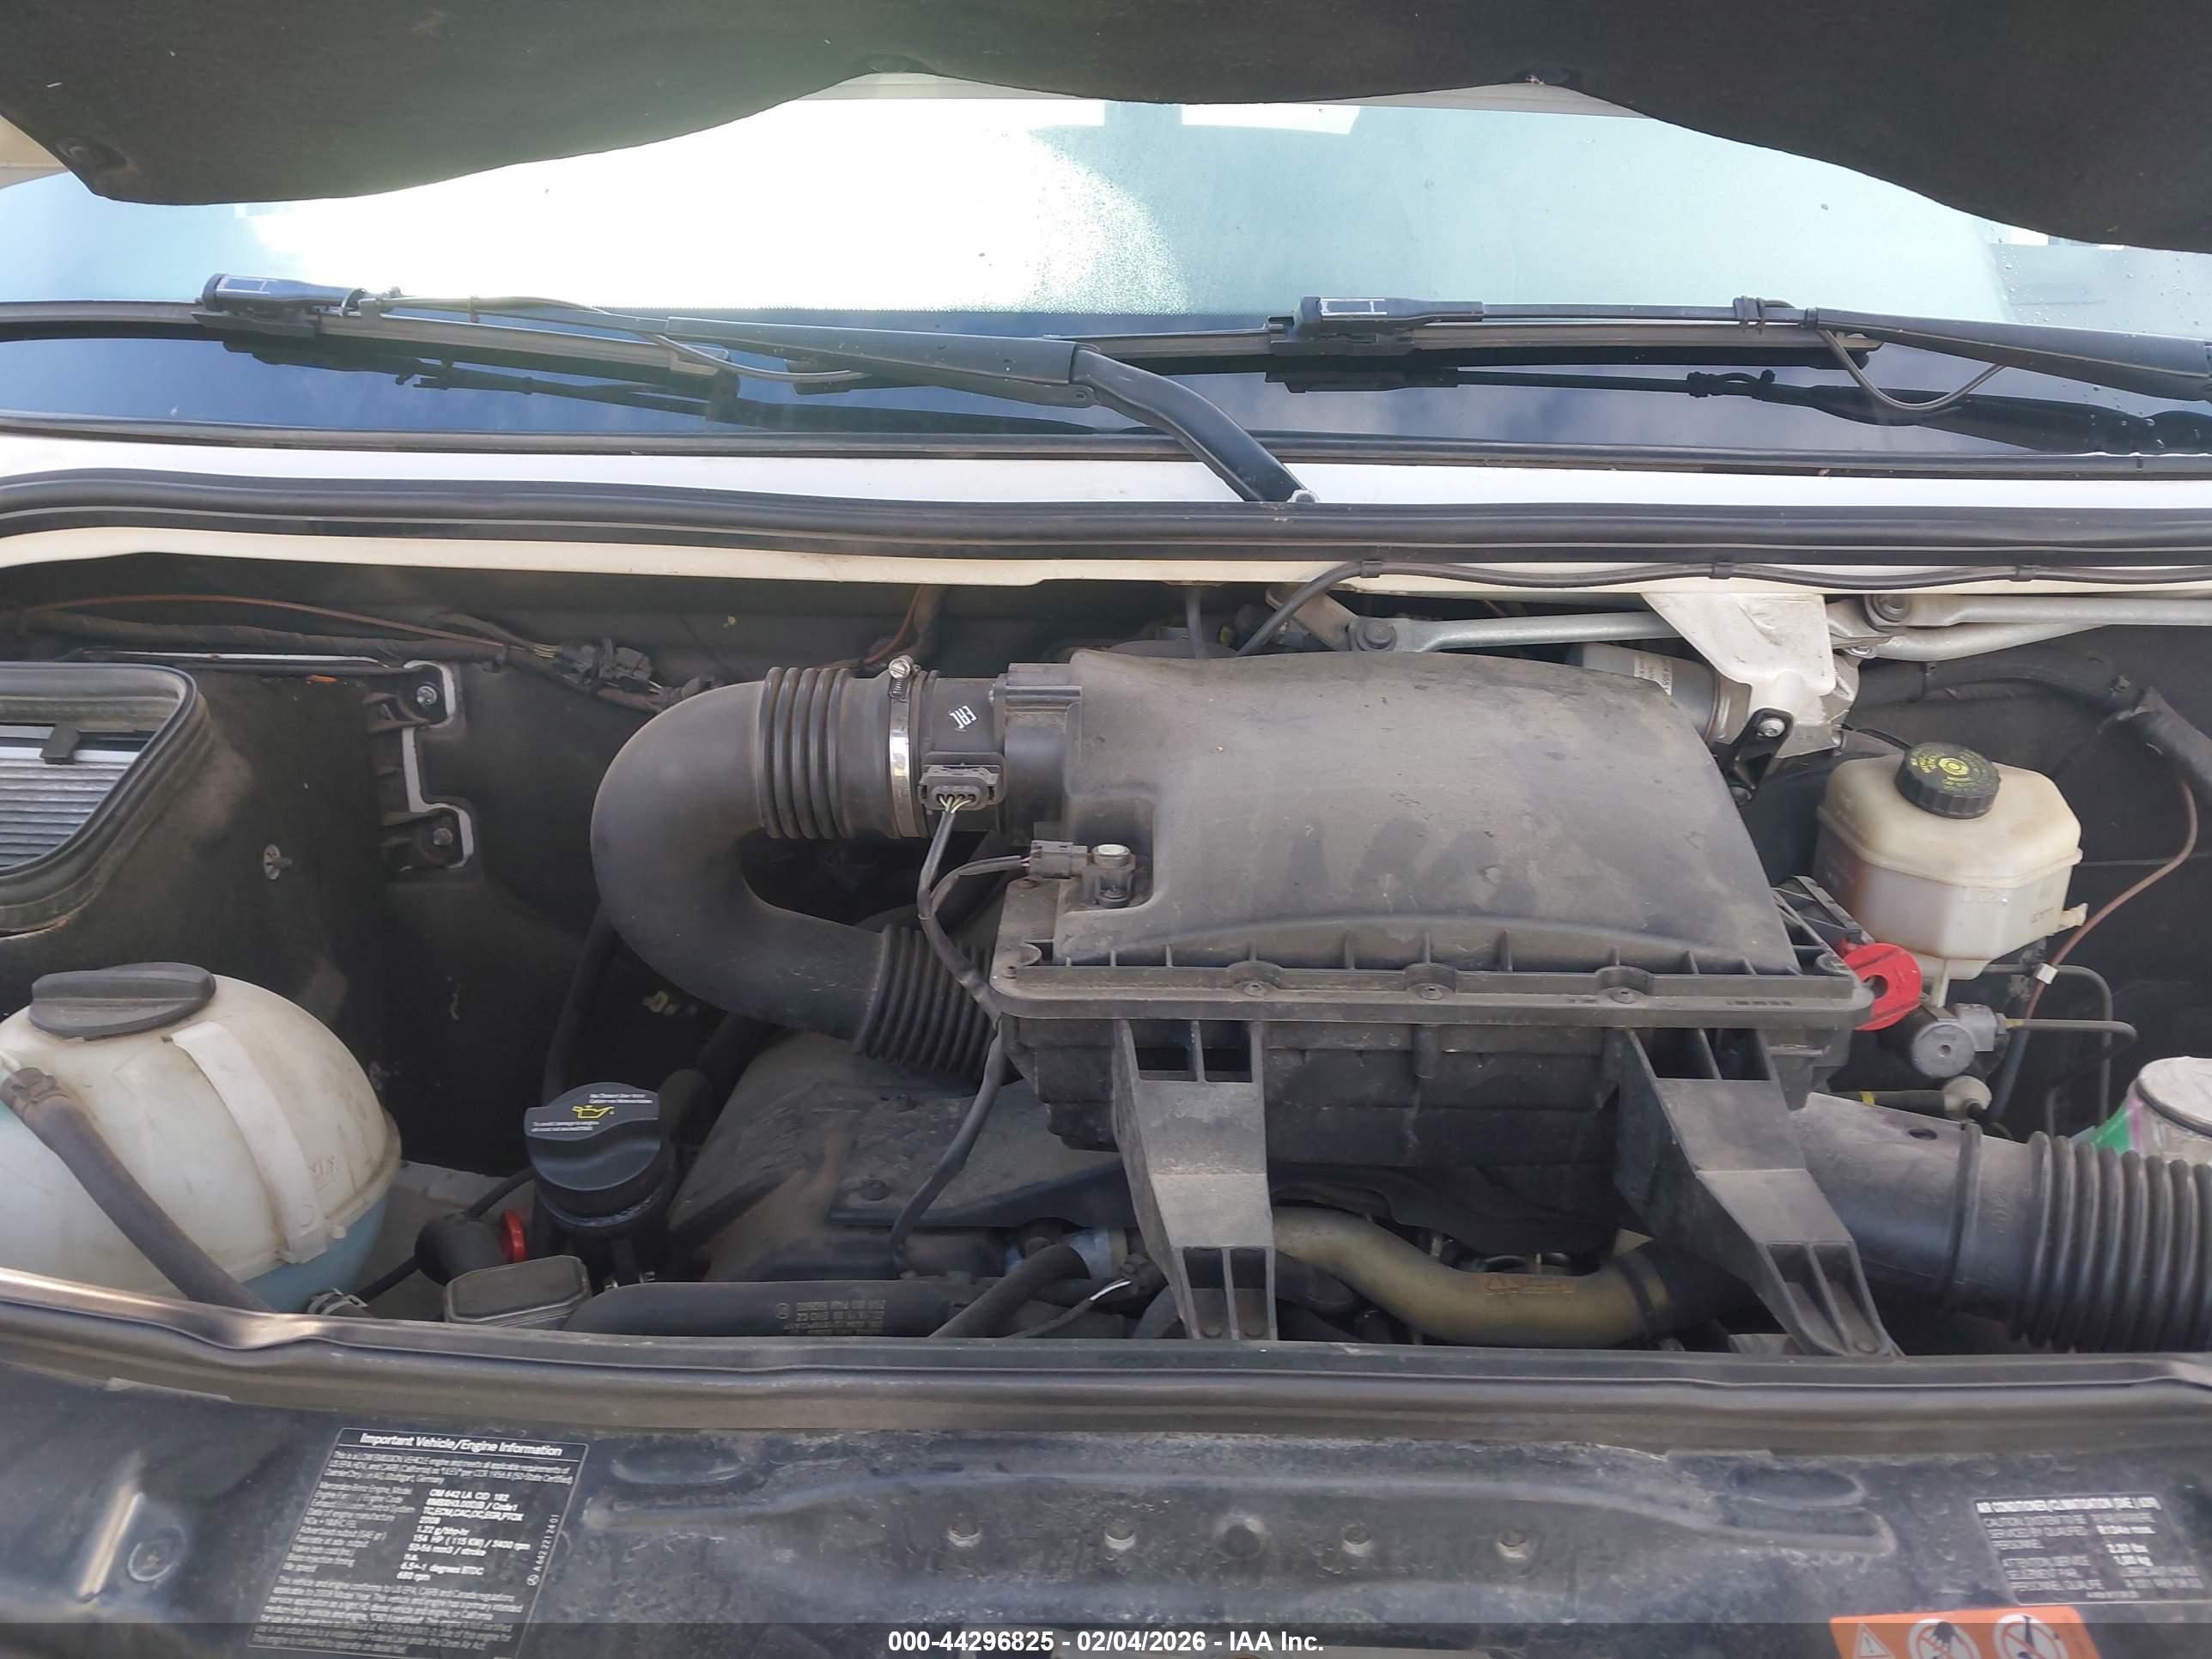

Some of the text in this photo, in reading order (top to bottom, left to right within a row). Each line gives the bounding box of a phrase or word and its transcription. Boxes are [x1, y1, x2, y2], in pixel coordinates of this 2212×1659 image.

[359, 1432, 562, 1456] Important Vehicle/Engine Information
